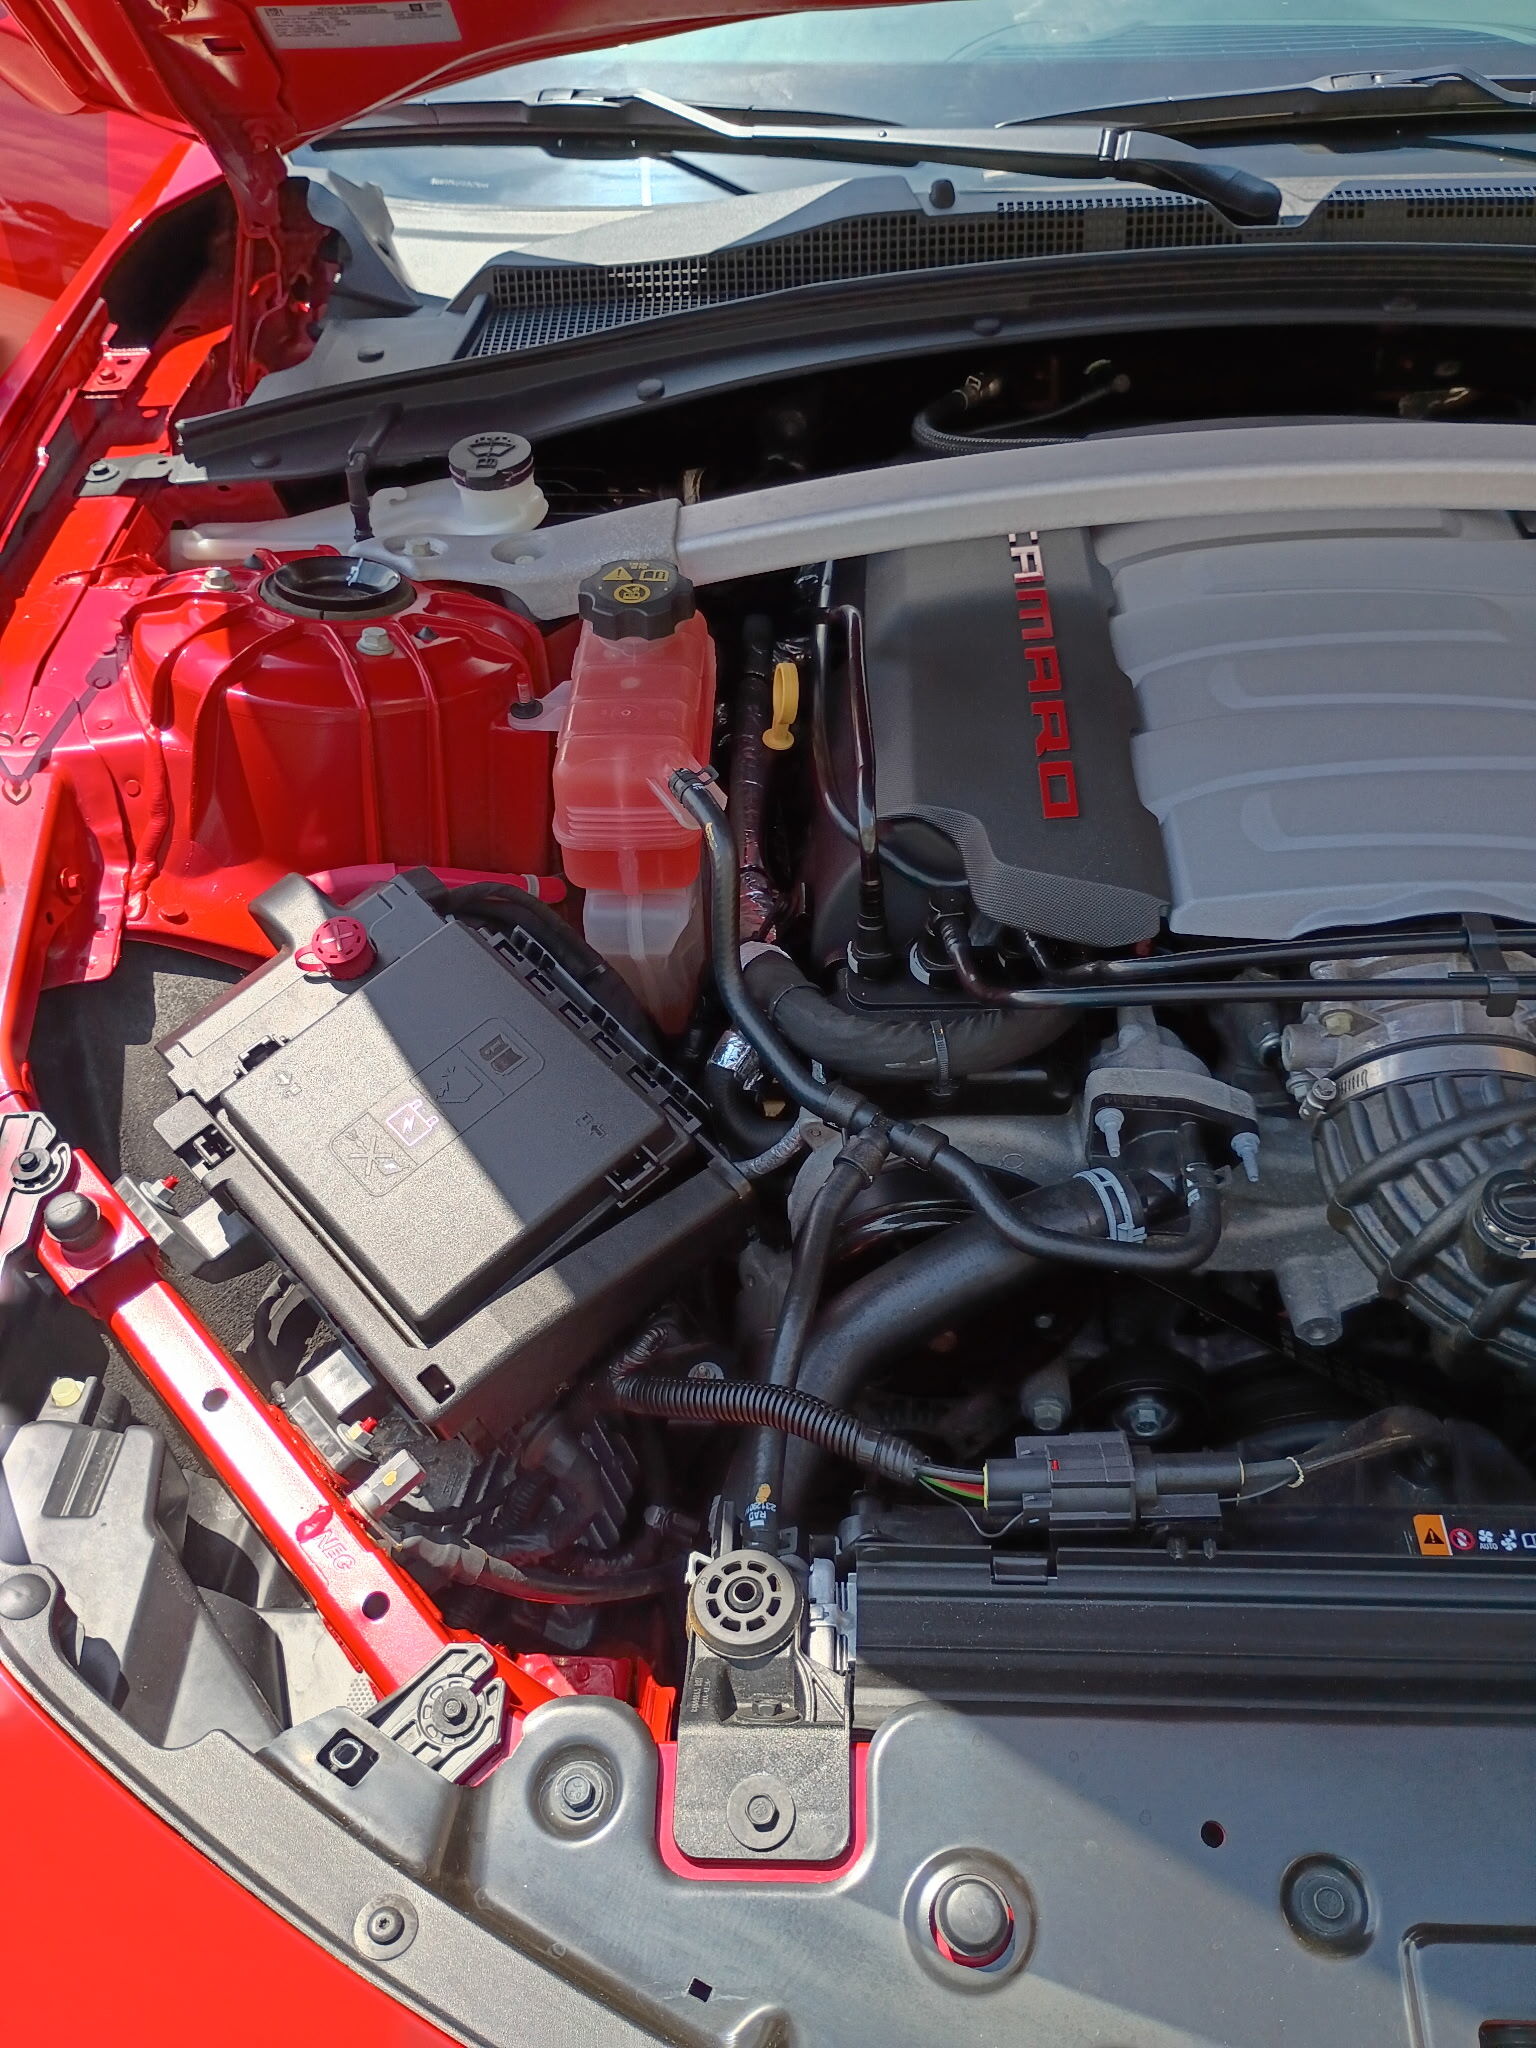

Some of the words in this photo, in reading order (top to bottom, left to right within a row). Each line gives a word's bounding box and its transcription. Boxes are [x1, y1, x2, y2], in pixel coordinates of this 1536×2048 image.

[748, 1511, 766, 1520] RAD
[314, 1529, 356, 1571] NEG
[1480, 1542, 1498, 1550] AUTO
